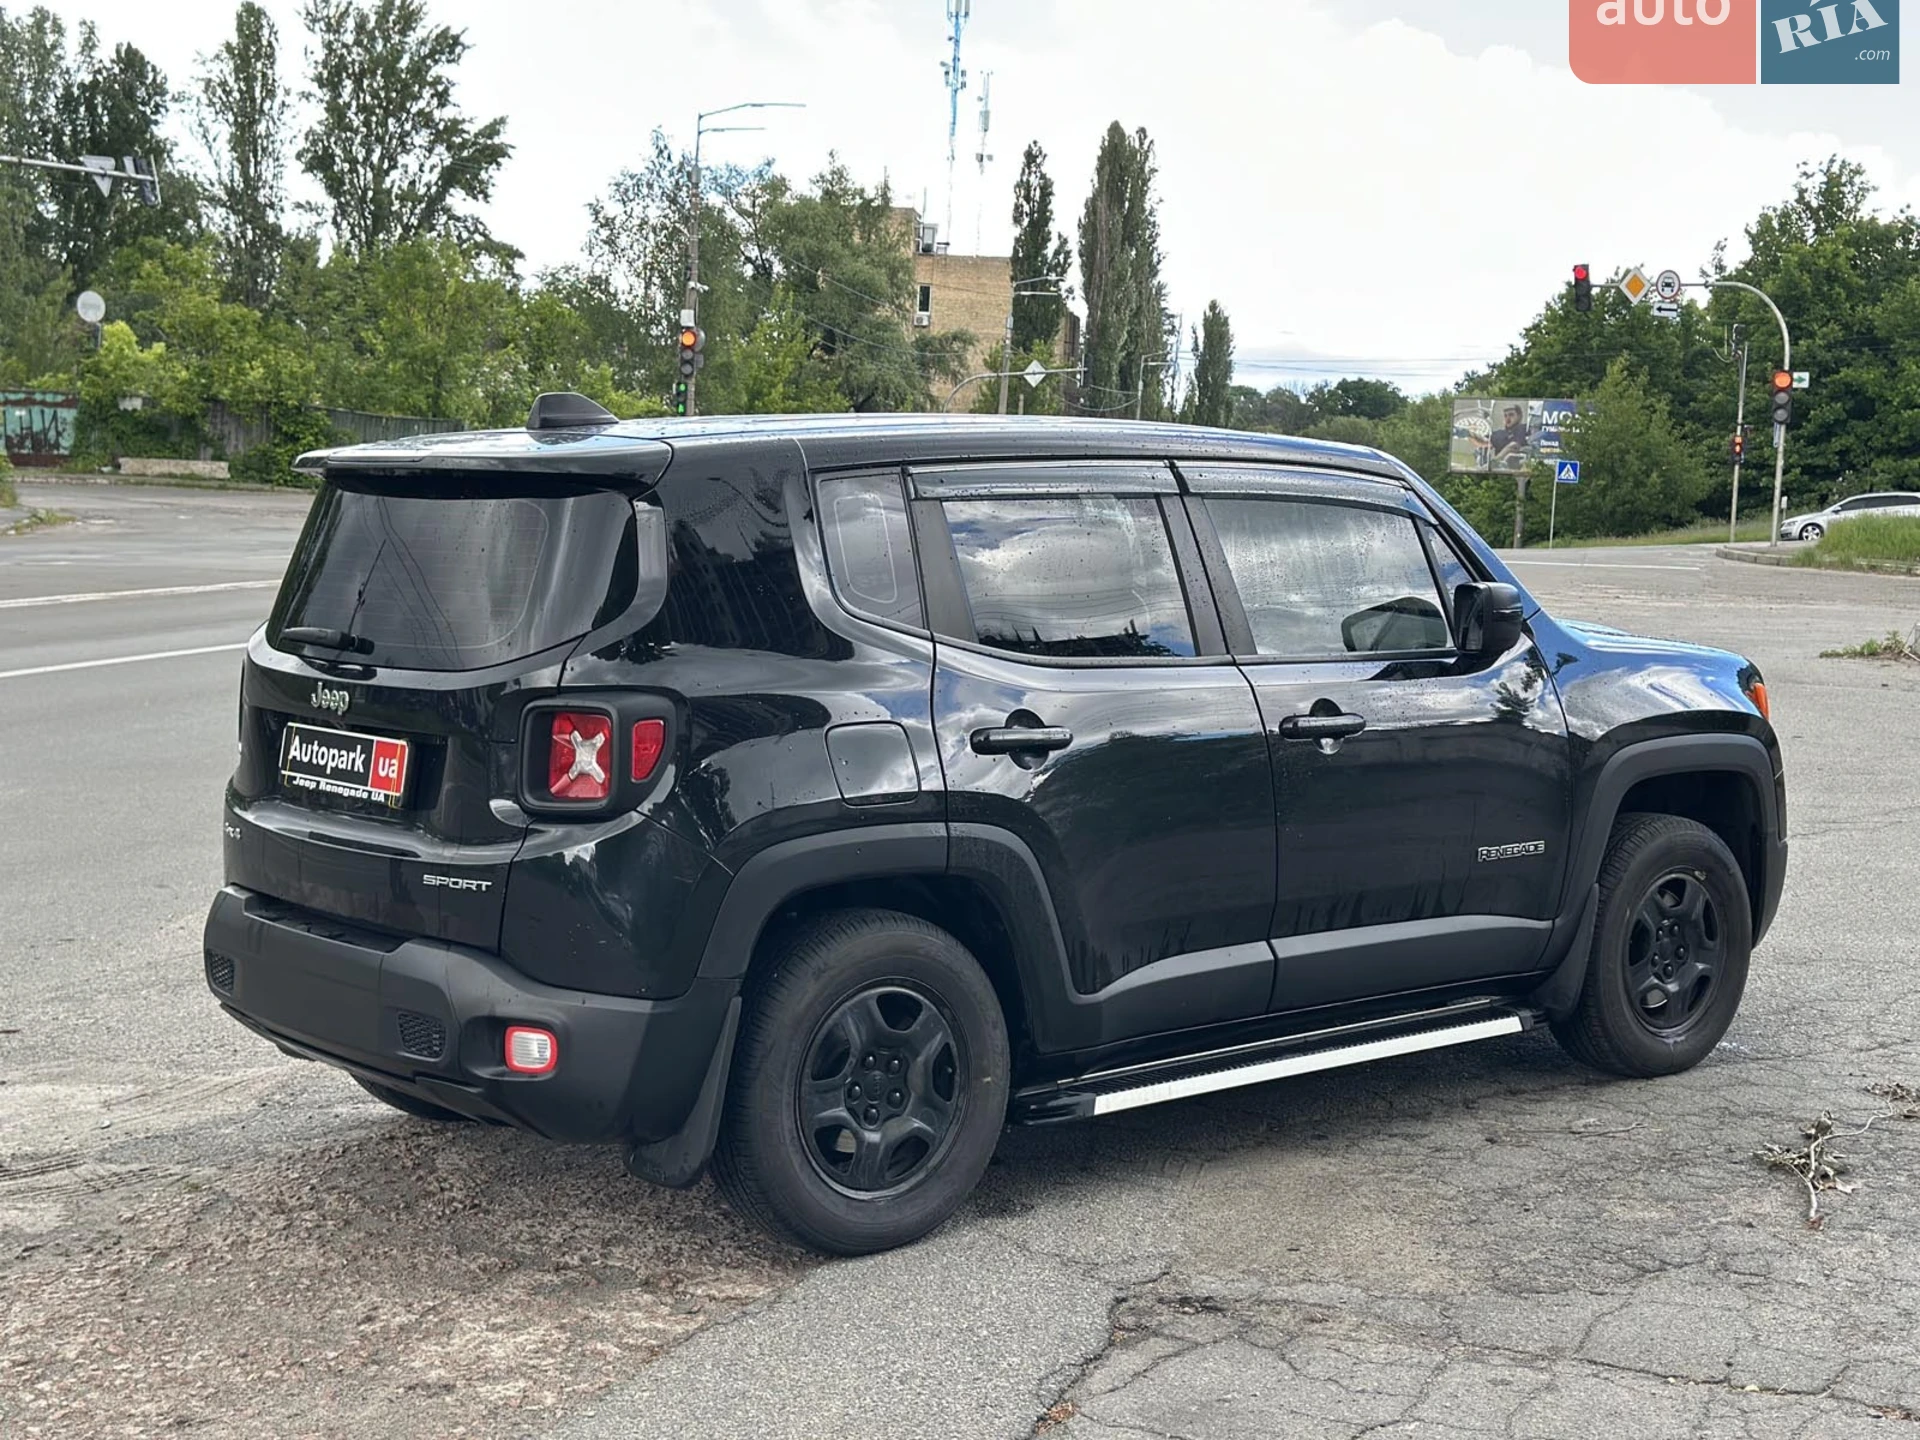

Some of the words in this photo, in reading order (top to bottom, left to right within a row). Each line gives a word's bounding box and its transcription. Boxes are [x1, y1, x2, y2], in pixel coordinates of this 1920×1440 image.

[311, 681, 350, 716] Jeep
[289, 735, 366, 774] Autopark
[378, 757, 398, 778] ua
[292, 776, 317, 790] Jeep
[319, 782, 369, 798] Renegade
[371, 791, 385, 803] UA
[1478, 841, 1544, 862] RENEGADE
[423, 875, 492, 891] SPORT
